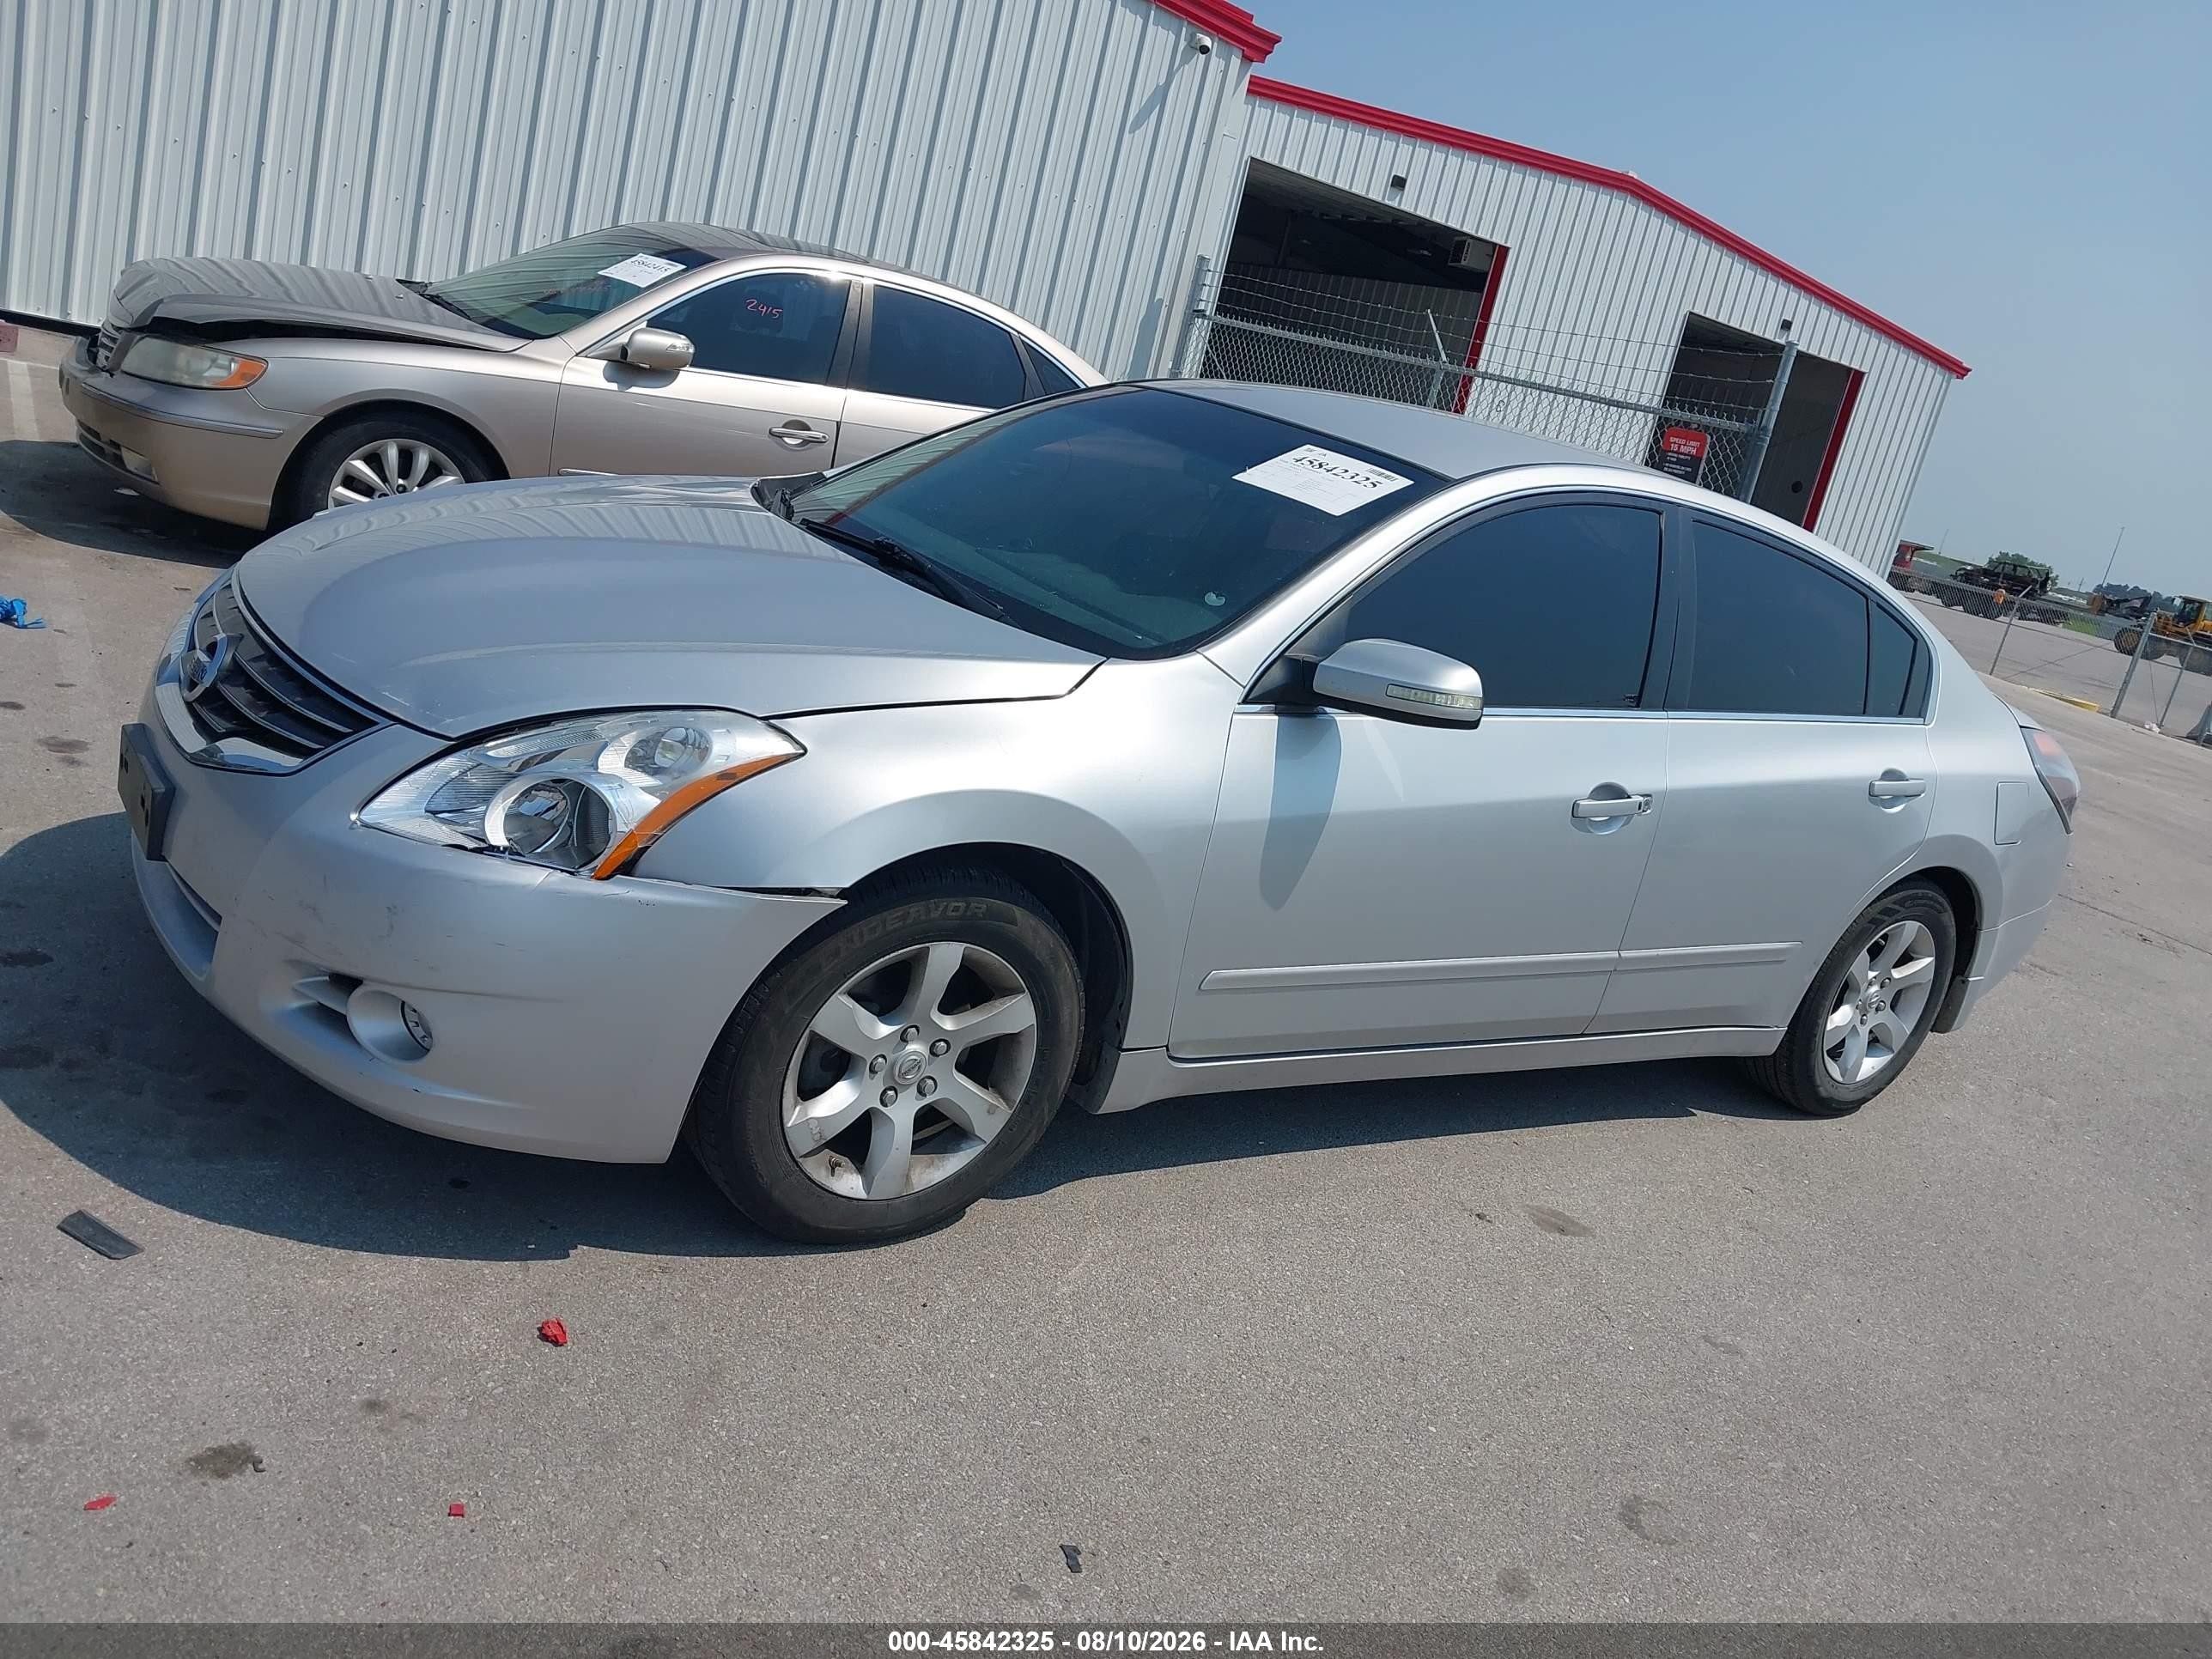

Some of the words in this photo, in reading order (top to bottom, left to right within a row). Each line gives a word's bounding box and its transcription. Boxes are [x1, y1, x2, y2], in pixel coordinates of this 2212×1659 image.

[746, 299, 783, 319] 2415
[1670, 443, 1680, 452] 15
[1680, 445, 1697, 455] MPH
[1292, 456, 1383, 489] 45842325
